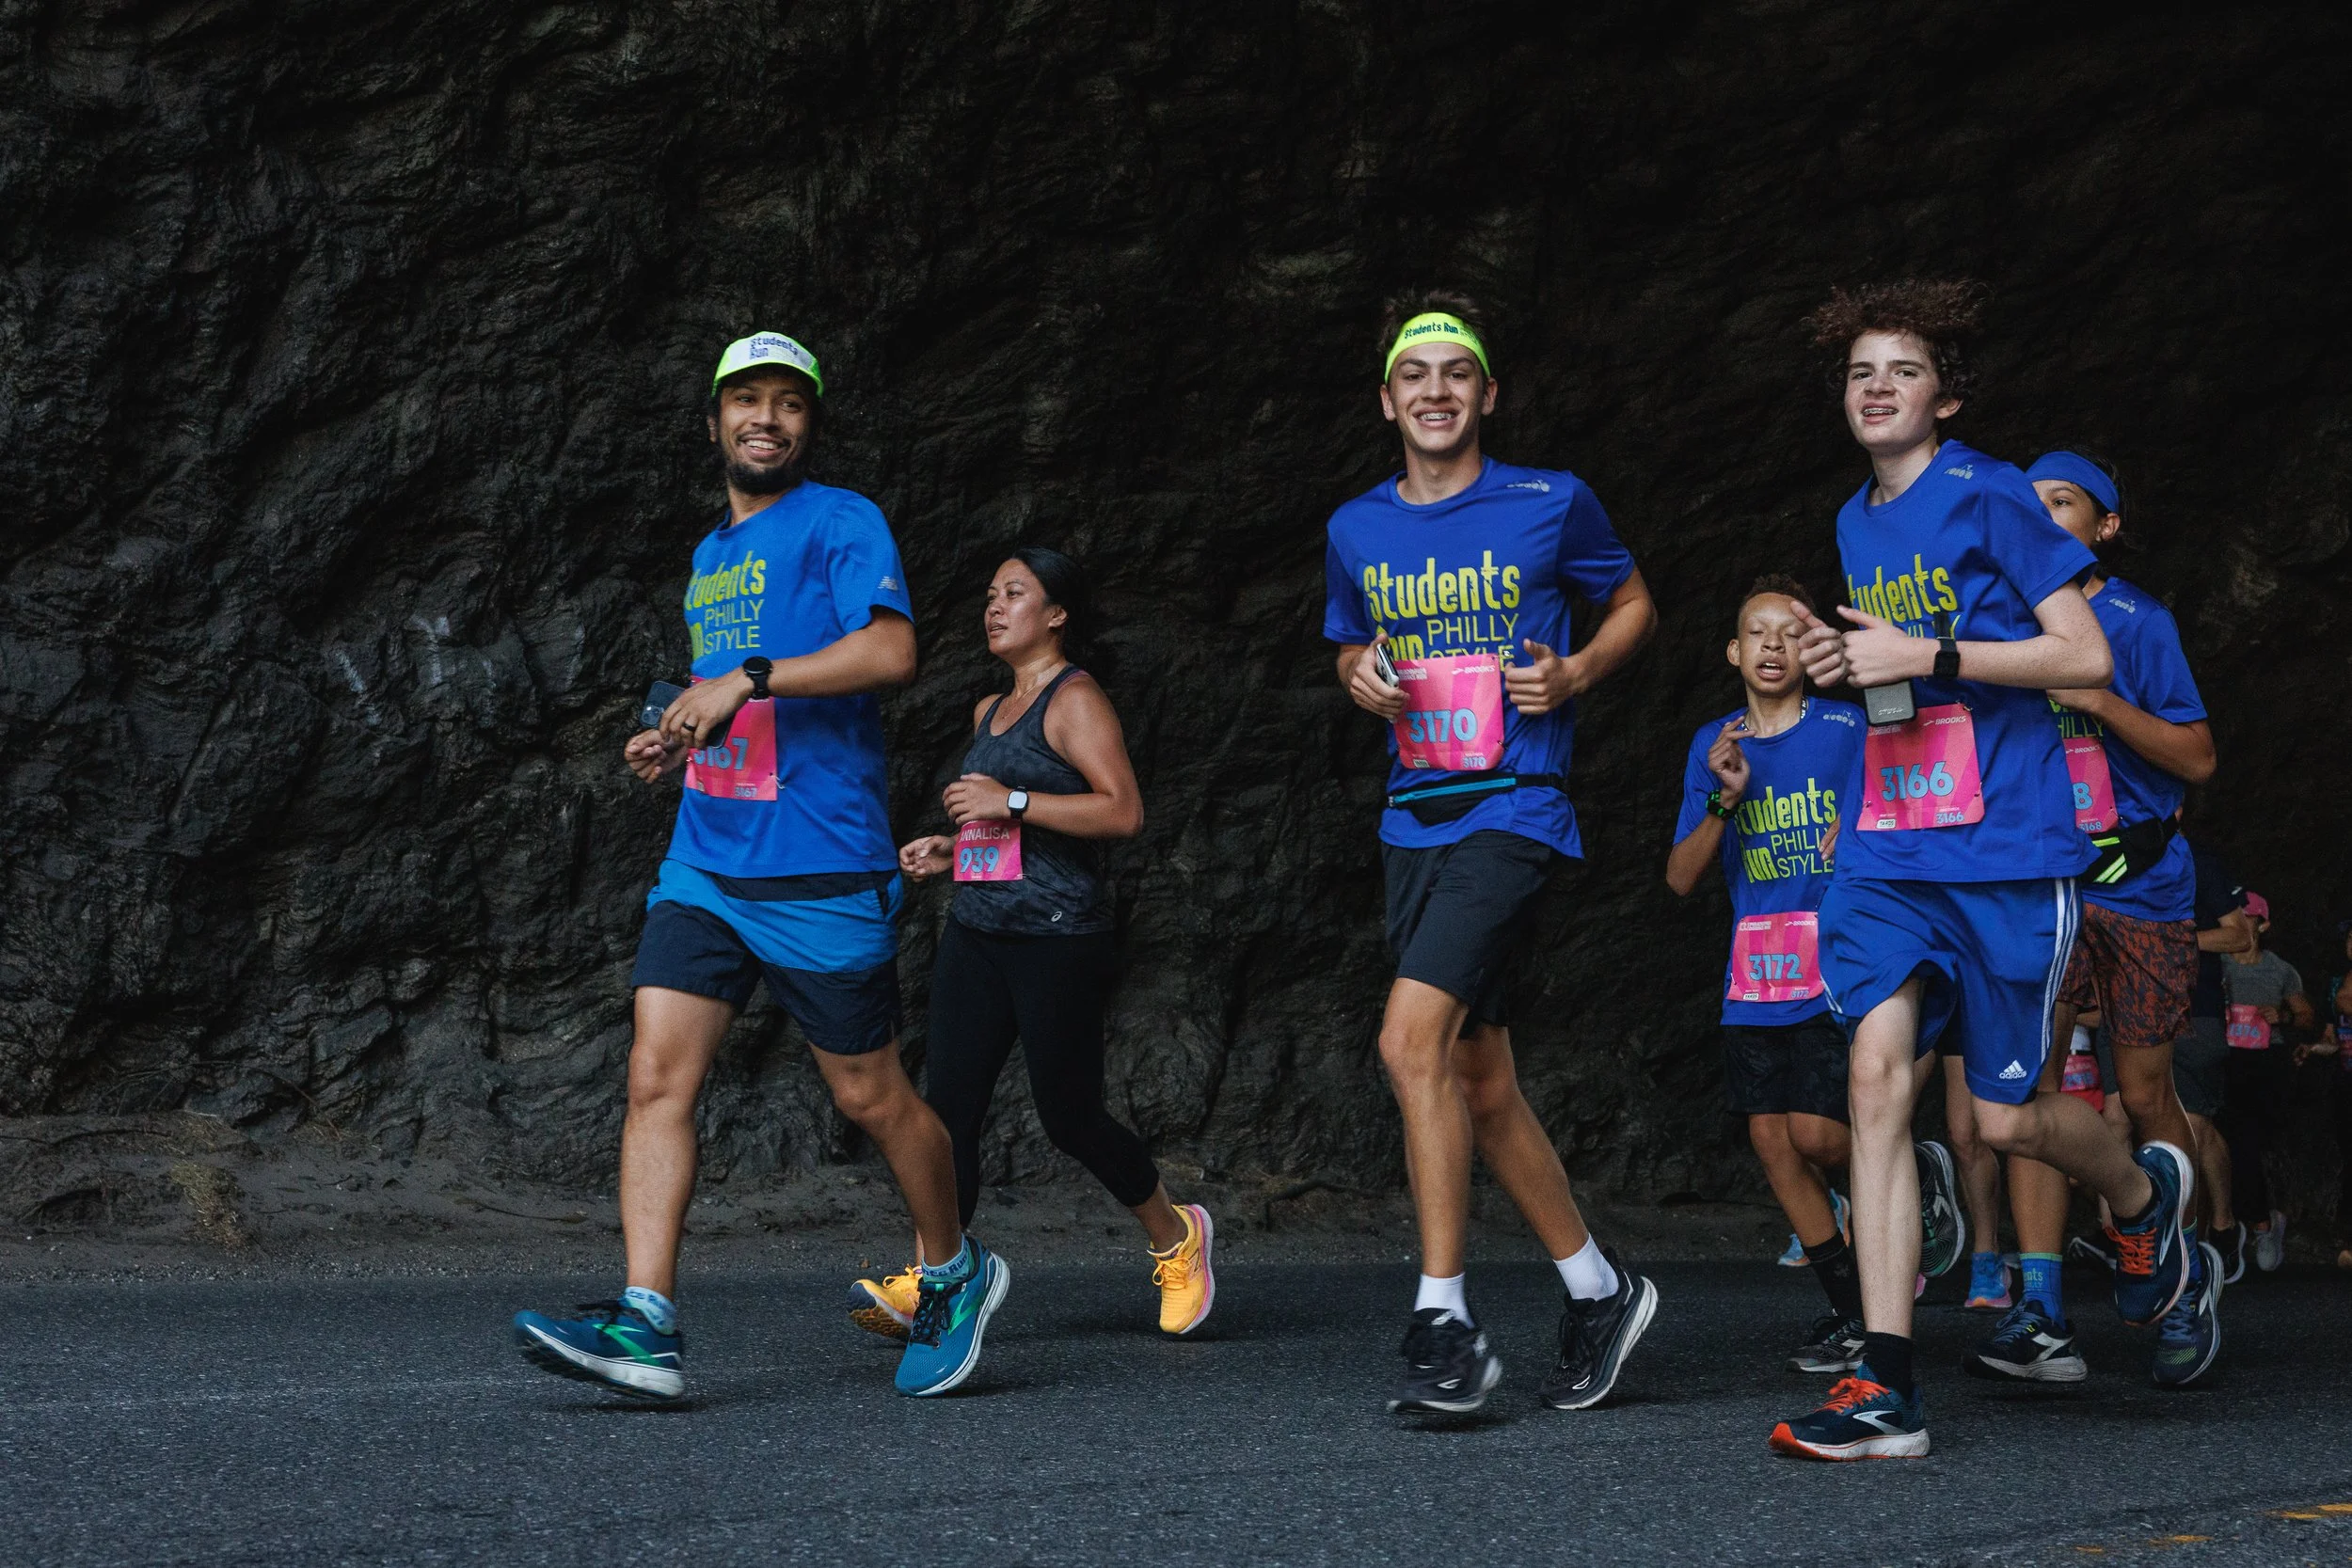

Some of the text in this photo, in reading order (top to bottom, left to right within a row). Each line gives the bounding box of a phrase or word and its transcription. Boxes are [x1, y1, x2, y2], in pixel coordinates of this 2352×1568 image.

[1405, 322, 1459, 339] Students Run
[750, 337, 798, 356] Students
[685, 550, 766, 610] tudents
[1363, 549, 1520, 623] Students
[1848, 553, 1958, 626] tudents
[705, 599, 765, 629] PHILLY
[704, 626, 761, 655] STYLE
[1426, 612, 1519, 646] PHILLY
[1406, 708, 1478, 743] 3170
[1935, 715, 1966, 725] BROOKS
[1463, 756, 1486, 768] 3170
[1880, 761, 1954, 801] 3166
[1735, 778, 1836, 835] tudents
[1936, 812, 1964, 824] 3166
[960, 827, 1010, 843] ANNALISA
[959, 846, 1000, 874] 939
[1748, 953, 1803, 981] 3172
